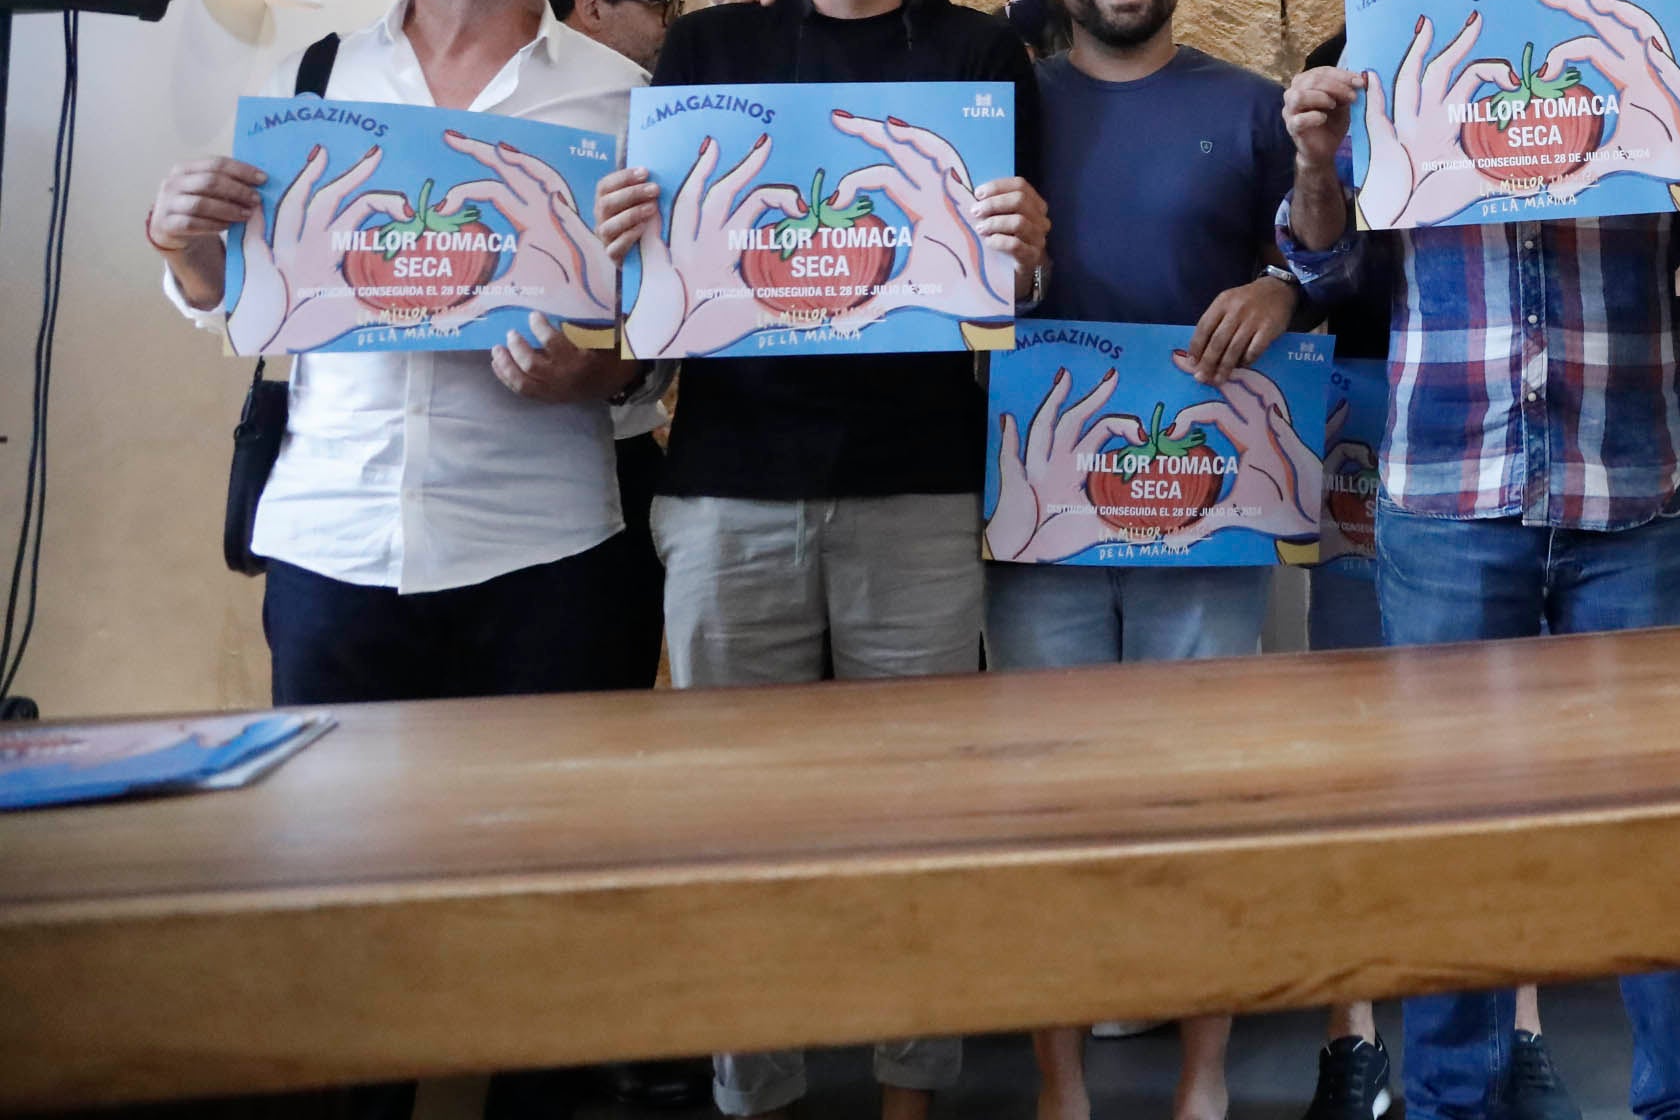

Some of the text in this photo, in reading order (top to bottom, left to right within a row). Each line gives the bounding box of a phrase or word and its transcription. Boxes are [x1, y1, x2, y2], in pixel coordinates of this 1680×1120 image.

[656, 94, 775, 125] MAGAZINOS
[962, 107, 1005, 119] TURIA
[1448, 94, 1619, 123] MILLOR TOMACA
[264, 107, 389, 138] MAGAZINOS
[1508, 125, 1562, 147] SECA
[569, 146, 608, 161] TURIA
[1478, 155, 1538, 168] CONSEGUIDA
[1583, 152, 1610, 162] JULIO
[1482, 204, 1497, 217] DE
[1502, 199, 1519, 212] LA
[332, 230, 517, 252] MILLOR TOMACA
[728, 226, 912, 250] MILLOR TOMACA
[393, 257, 452, 278] SECA
[791, 255, 849, 277] SECA
[358, 287, 423, 296] CONSEGUIDA
[757, 287, 822, 298] CONSEGUIDA
[758, 336, 774, 349] DE
[780, 331, 798, 344] LA
[1015, 329, 1123, 360] MAGAZINOS
[1288, 351, 1324, 362] TURIA
[1077, 454, 1238, 474] MILLOR TOMACA
[1131, 480, 1181, 499] SECA
[1100, 506, 1157, 516] CONSEGUIDA
[1100, 549, 1113, 560] DE
[1118, 545, 1134, 558] LA
